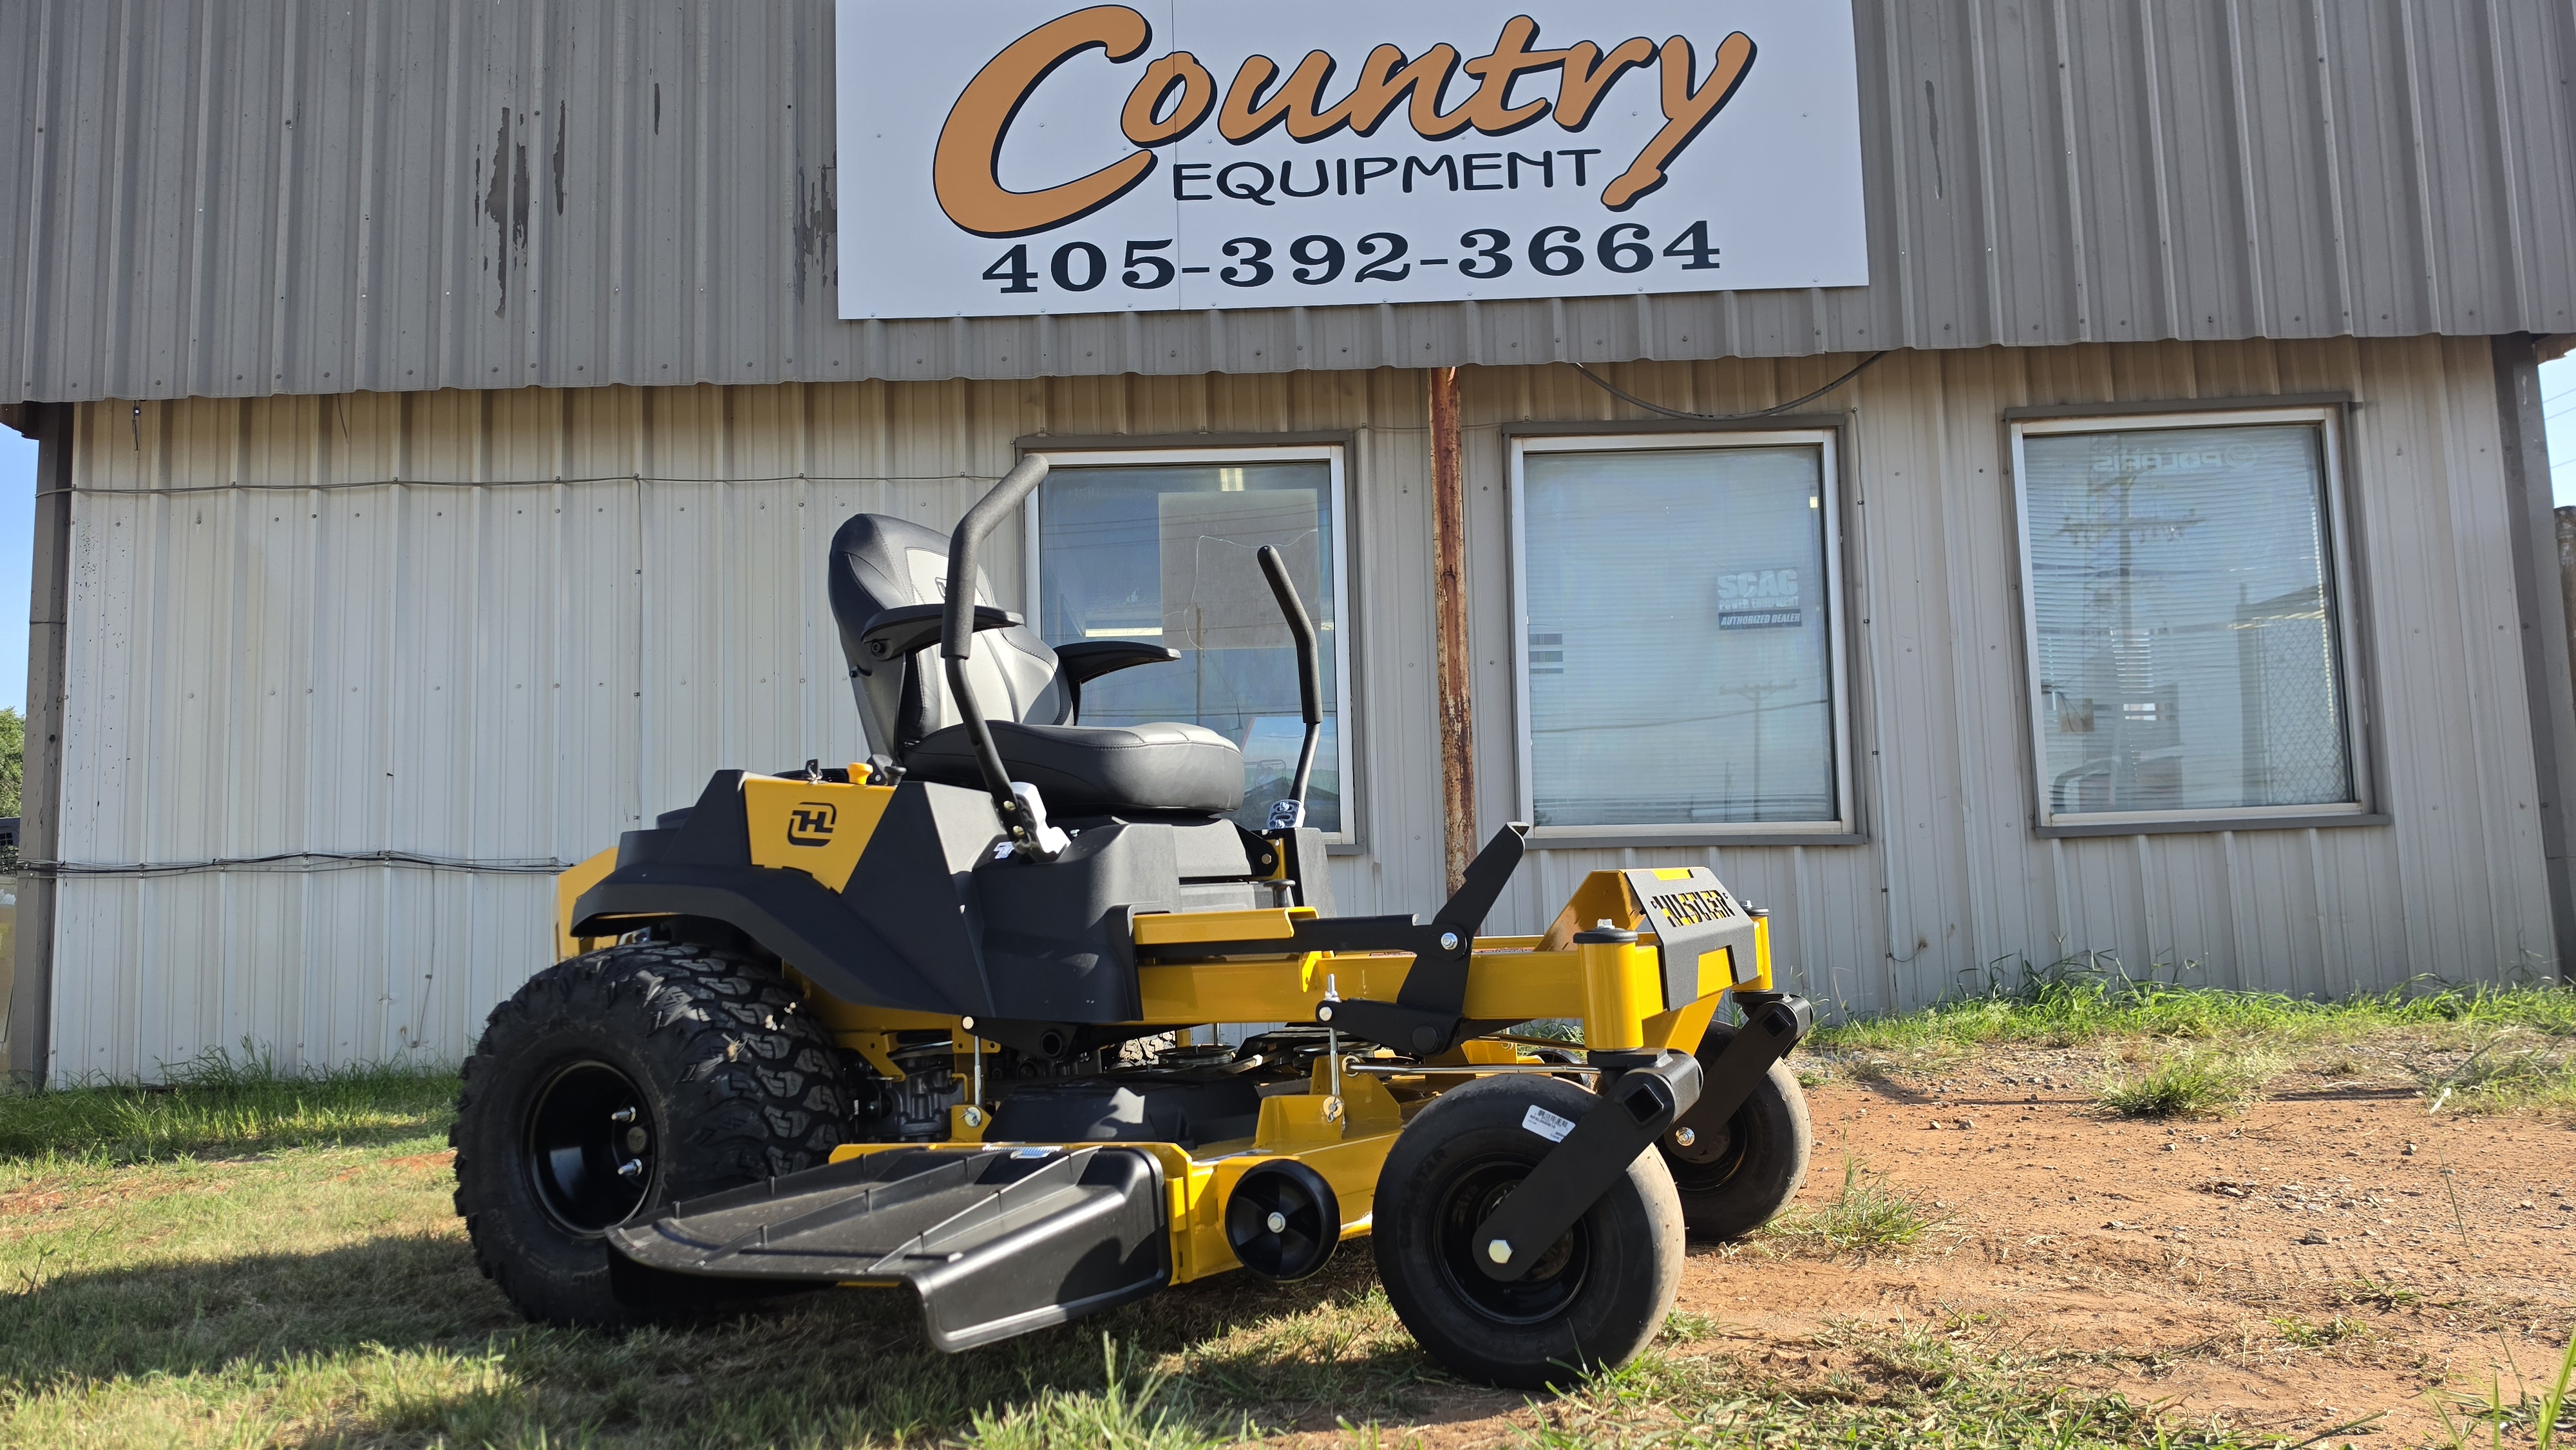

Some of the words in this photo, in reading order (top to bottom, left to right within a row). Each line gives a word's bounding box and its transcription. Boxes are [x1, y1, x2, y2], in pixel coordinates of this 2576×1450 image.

[932, 4, 1758, 240] Country
[1172, 148, 1602, 206] EQUIPMENT
[981, 220, 1721, 294] 405-392-3664
[1717, 569, 1798, 598] SCAG
[1719, 599, 1749, 610] POWER
[1751, 596, 1799, 608] EQUIPMENT
[1721, 614, 1770, 626] AUTHORIZED
[1771, 613, 1801, 623] DEALER
[1651, 889, 1736, 928] HUSTLER
